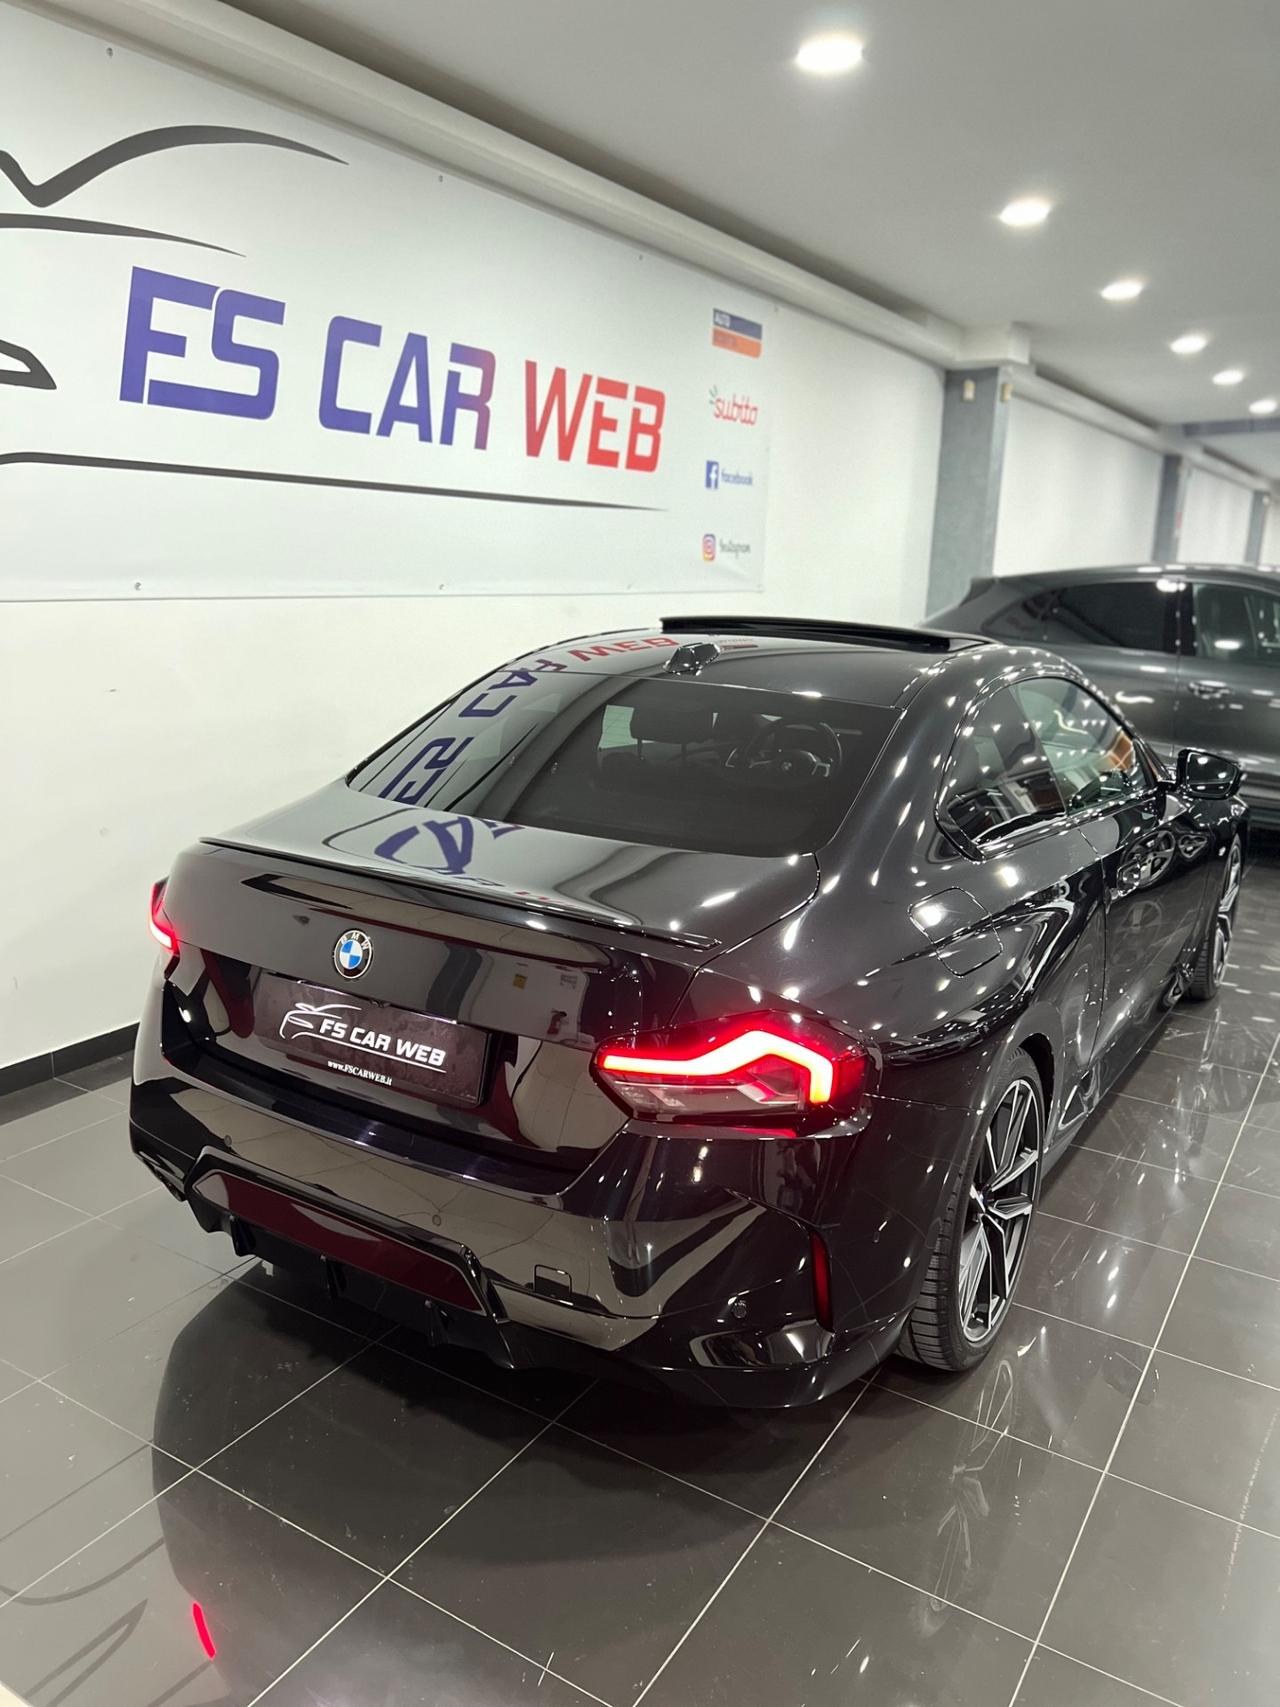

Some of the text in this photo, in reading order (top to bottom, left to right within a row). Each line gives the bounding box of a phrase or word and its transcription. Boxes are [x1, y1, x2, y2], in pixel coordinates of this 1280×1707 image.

[318, 315, 496, 450] CAR
[525, 360, 666, 473] WEB
[319, 1018, 446, 1066] FS CAR WEB
[327, 1060, 392, 1085] www.FSCARWEB.it
